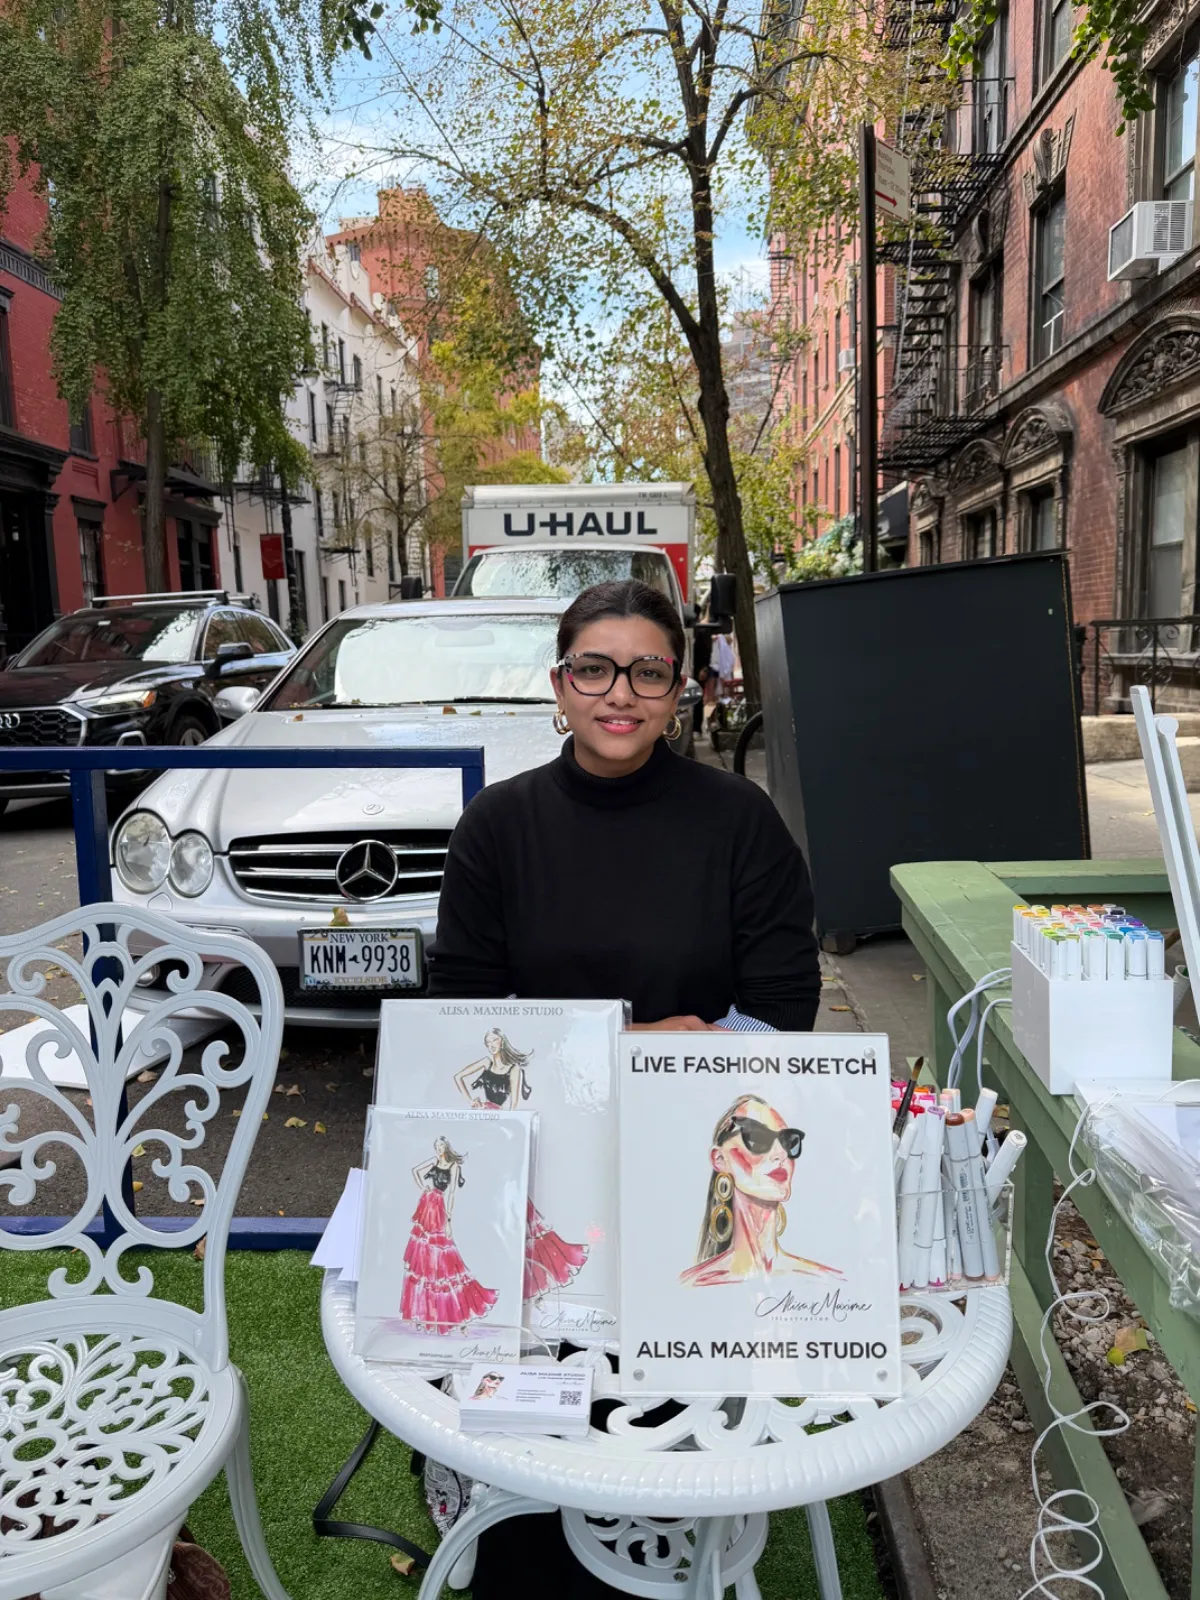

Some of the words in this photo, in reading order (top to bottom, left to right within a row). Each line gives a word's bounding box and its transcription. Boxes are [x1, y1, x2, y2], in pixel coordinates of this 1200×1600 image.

[503, 511, 658, 537] U-HAUL
[330, 933, 357, 943] NEW
[358, 933, 389, 943] YORK
[310, 945, 347, 974] KNM
[361, 944, 411, 973] 9938
[438, 1006, 470, 1016] ALISA
[473, 1006, 520, 1016] MAXIME
[522, 1006, 564, 1016] STUDIO
[631, 1056, 677, 1073] LIVE
[684, 1056, 780, 1074] FASHION
[787, 1057, 877, 1075] SKETCH
[404, 1111, 429, 1119] ALISA
[431, 1111, 467, 1120] MAXIME
[468, 1112, 500, 1121] STUDIO
[755, 1289, 811, 1318] Alisa
[810, 1287, 873, 1322] Maxime
[636, 1341, 703, 1359] ALISA
[710, 1341, 799, 1359] MAXIME
[806, 1341, 887, 1359] STUDIO
